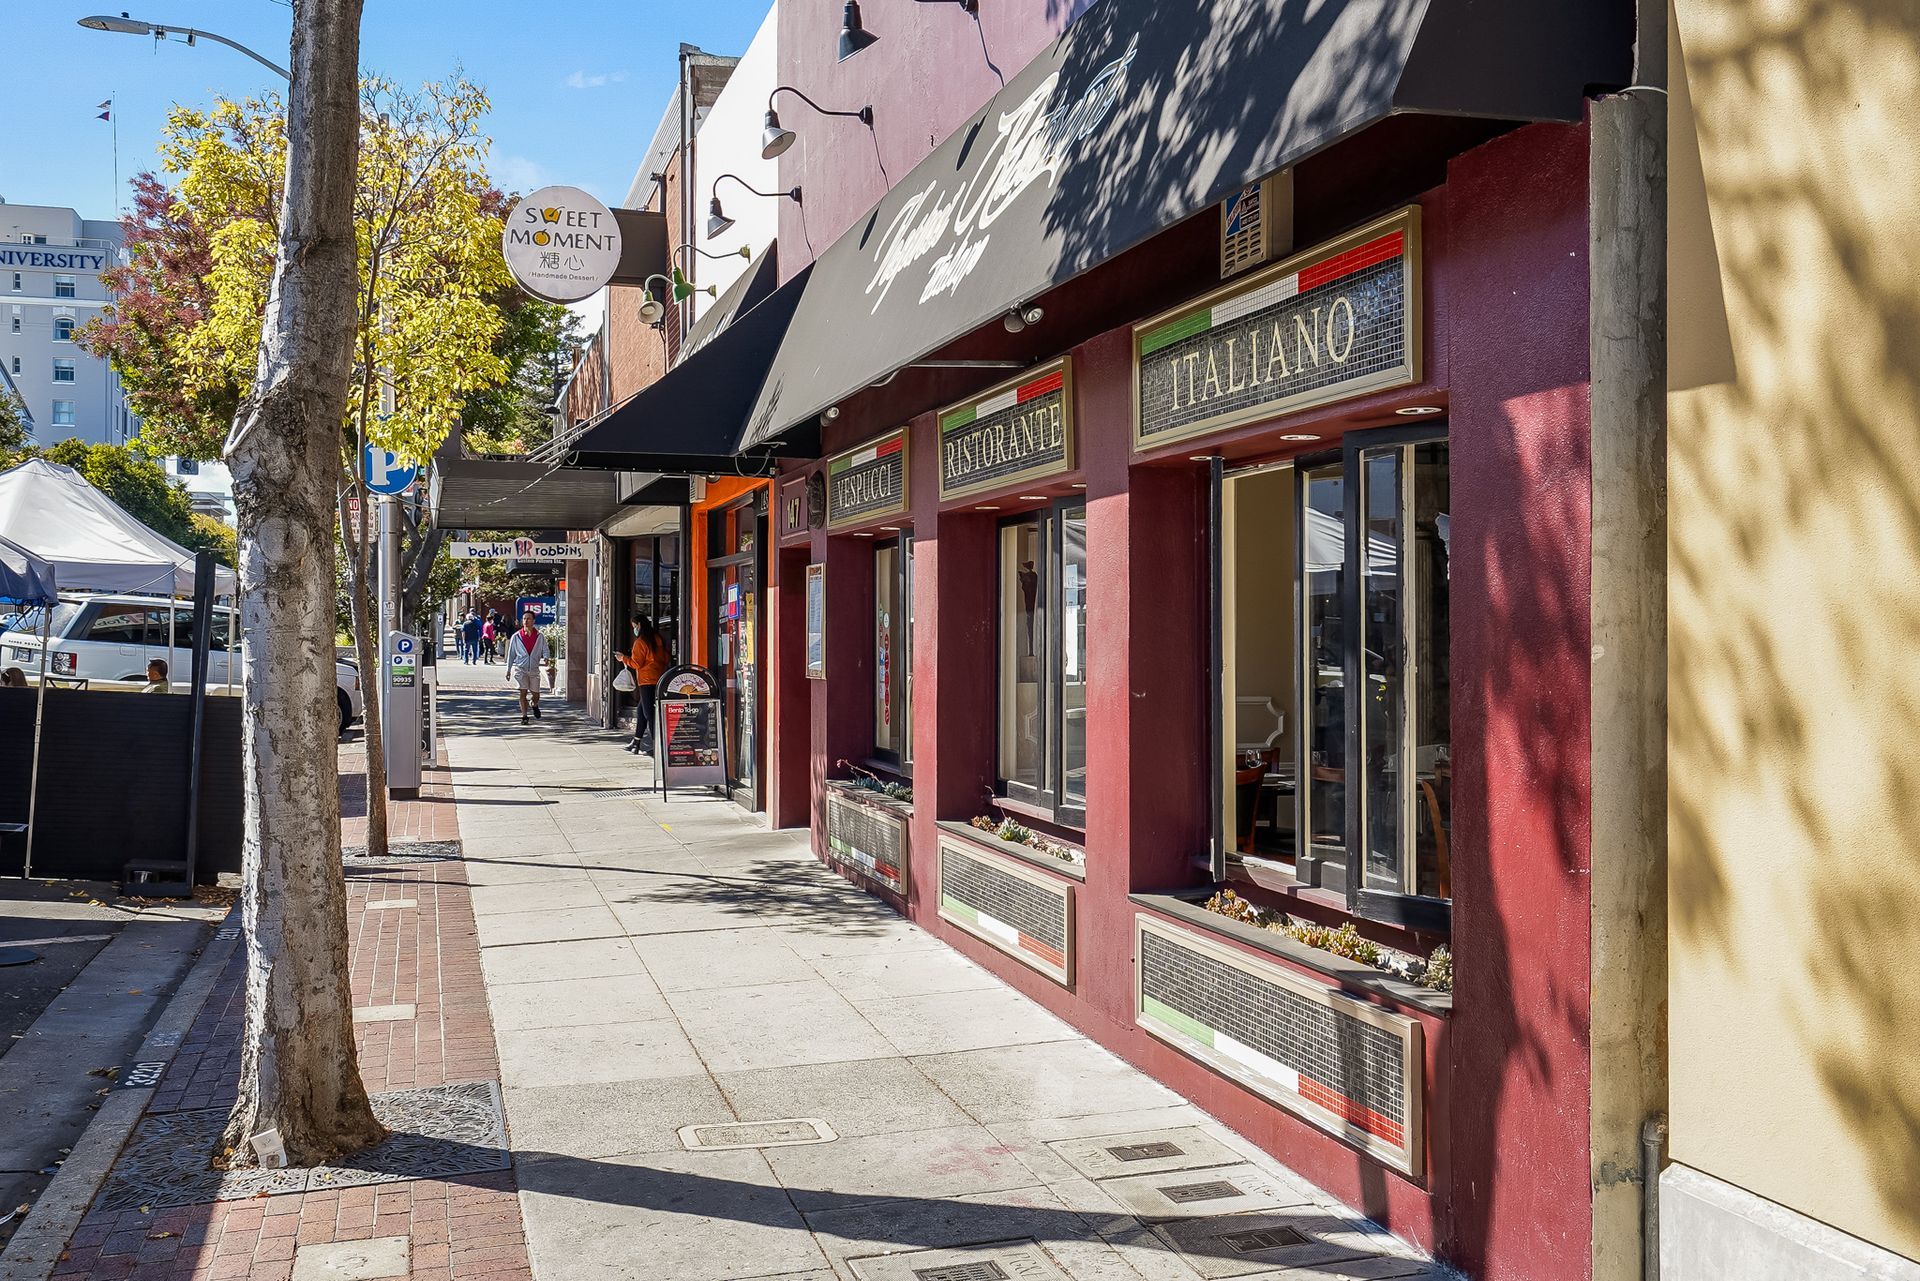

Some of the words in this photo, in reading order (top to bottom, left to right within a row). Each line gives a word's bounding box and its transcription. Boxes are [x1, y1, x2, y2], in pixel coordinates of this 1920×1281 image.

[525, 206, 602, 229] SWEET
[510, 228, 616, 251] MOMENT
[539, 251, 585, 271] 糖心
[1171, 296, 1355, 411] ITALIANO
[946, 402, 1063, 479] RISTORANTE
[368, 447, 401, 486] P
[837, 463, 892, 508] VESPUCCI
[787, 497, 800, 529] 147
[468, 542, 512, 558] baskin
[535, 544, 583, 557] robbins
[401, 641, 410, 651] P
